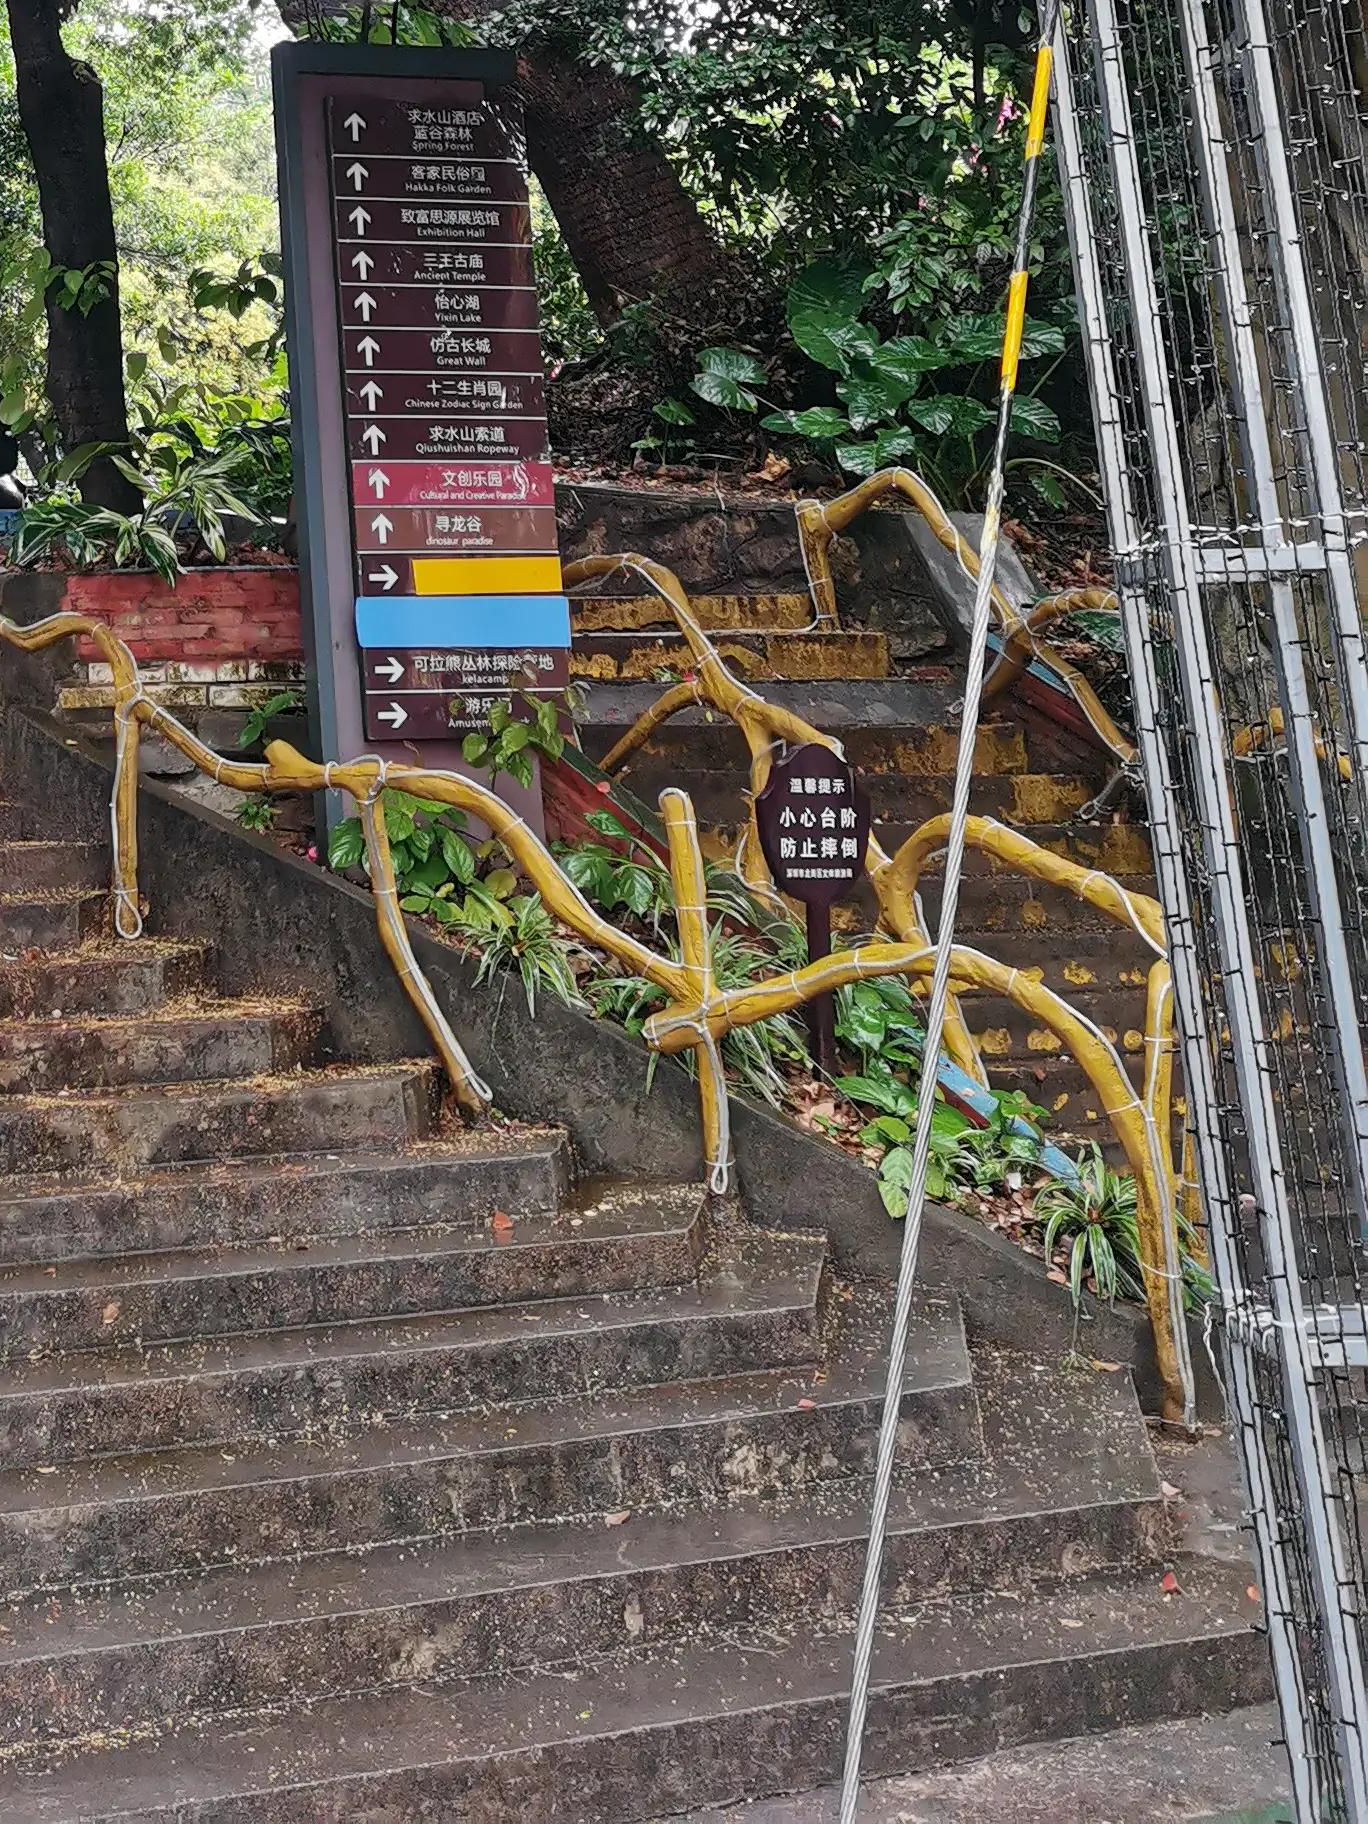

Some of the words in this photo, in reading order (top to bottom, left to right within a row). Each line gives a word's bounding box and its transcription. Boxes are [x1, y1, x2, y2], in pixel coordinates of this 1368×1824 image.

[408, 108, 481, 126] 求水山酒店
[412, 140, 443, 152] Spring
[445, 141, 474, 152] Forest
[405, 183, 434, 193] Hakka
[436, 183, 455, 193] Folk
[458, 184, 492, 194] Garden
[400, 208, 500, 226] 致富思源展览馆
[417, 227, 464, 238] Exhibition
[466, 228, 485, 238] Hall
[423, 252, 484, 269] 三王古庙
[414, 270, 450, 280] Ancient
[452, 271, 487, 282] Temple
[434, 294, 480, 310] 怡心湖
[434, 312, 458, 322] Yixin
[459, 313, 482, 323] Lake
[431, 337, 491, 354] 仿古长城
[436, 356, 463, 366] Great
[464, 356, 486, 366] Wall
[426, 379, 503, 397] 十二生肖园
[405, 398, 440, 408] Chinese
[442, 399, 470, 409] Zodiac
[472, 399, 492, 411] Sign
[429, 425, 506, 443] 求水山索道
[415, 443, 476, 454] Qiushuishan
[477, 443, 520, 456] Ropeway
[440, 470, 504, 487] 文创乐园
[451, 490, 464, 499] and
[466, 491, 495, 500] Creative
[435, 514, 482, 532] 寻龙谷
[425, 536, 459, 546] dinosaur
[462, 536, 494, 548] paradise
[789, 777, 846, 794] 温馨提示
[779, 805, 858, 829] 小心台阶
[780, 836, 858, 860] 防止摔倒
